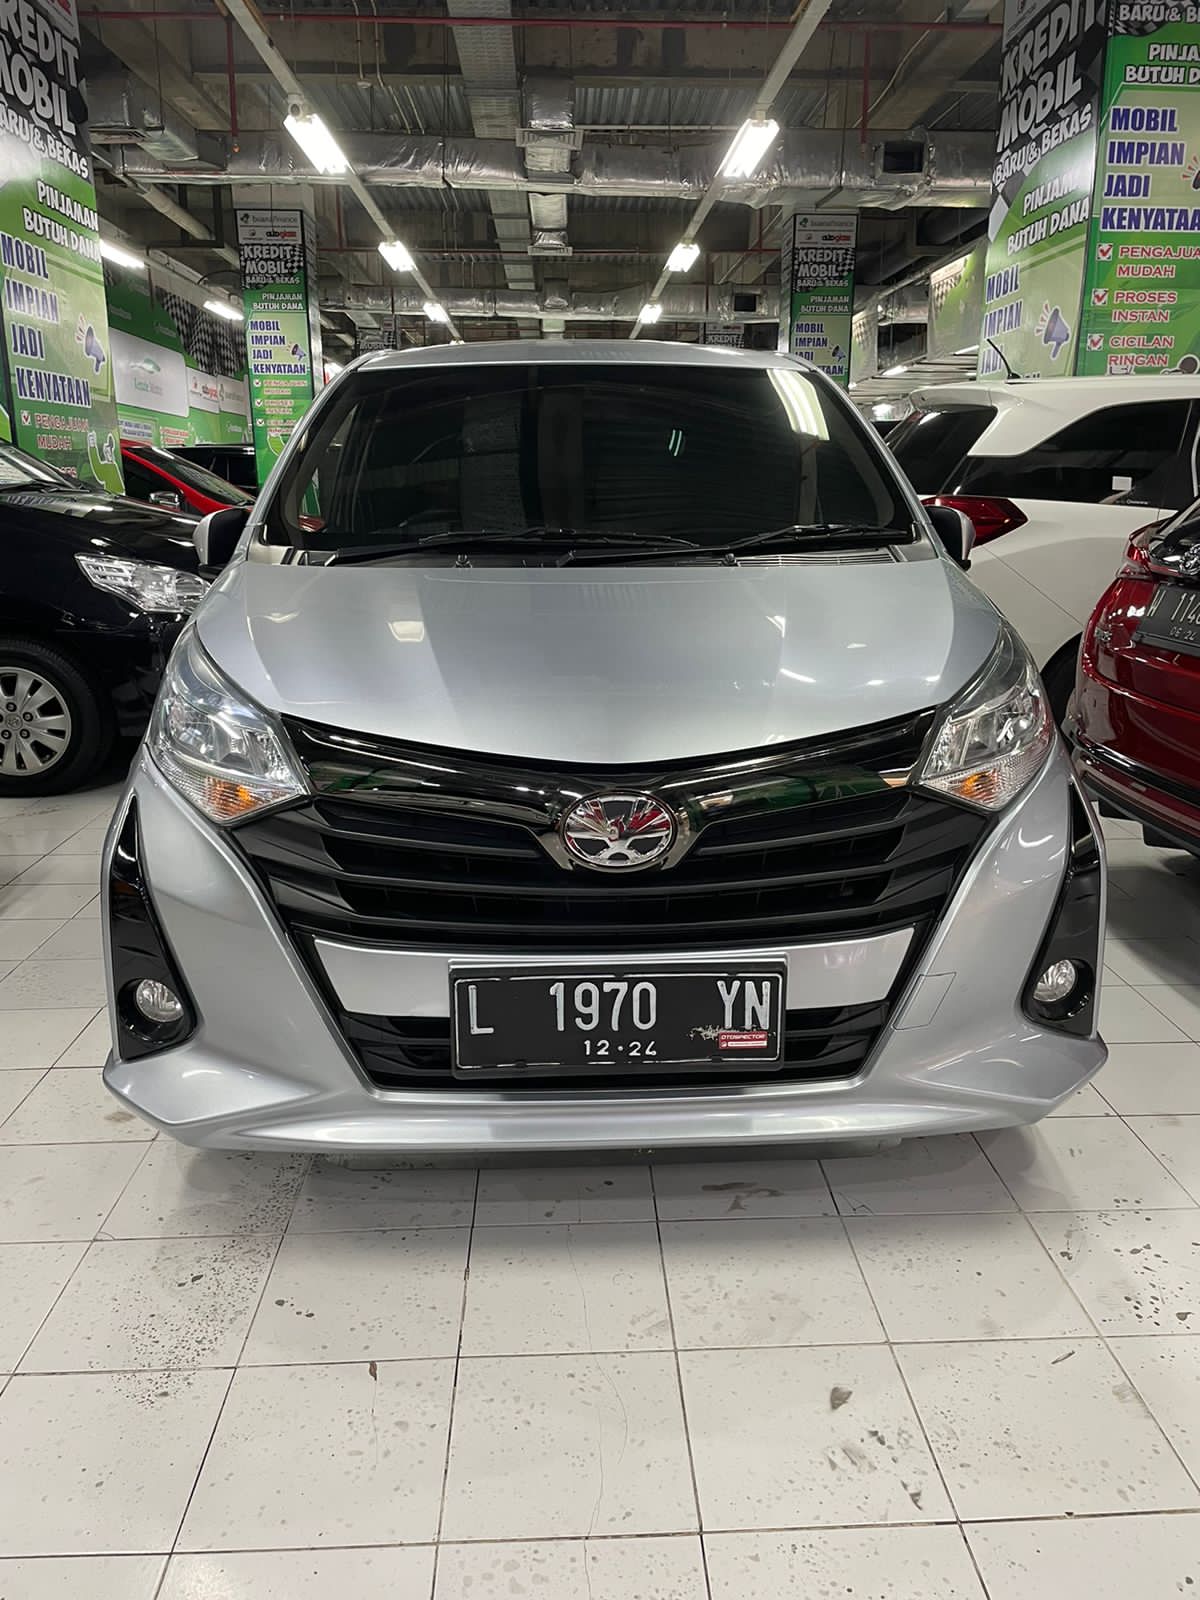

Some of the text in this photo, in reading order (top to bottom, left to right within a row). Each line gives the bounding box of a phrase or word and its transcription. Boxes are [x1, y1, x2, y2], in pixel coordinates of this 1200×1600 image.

[1119, 4, 1166, 22] BARU
[1168, 7, 1182, 22] &
[1125, 65, 1185, 83] BUTUH
[997, 51, 1082, 153] MOBIL
[1110, 107, 1178, 132] MOBIL
[993, 103, 1092, 187] BARU & BEKAS
[33, 128, 45, 151] &
[47, 134, 89, 179] BEKAS
[1107, 141, 1185, 165] IMPIAN
[1103, 174, 1150, 198] JADI
[37, 180, 99, 232] PINJAMAN
[23, 208, 69, 247] BUTUH
[1007, 197, 1090, 256] BUTUH DANA
[1, 232, 49, 279] MOBIL
[243, 245, 293, 259] KREDIT
[799, 249, 846, 262] KREDIT
[245, 260, 289, 274] MOBIL
[797, 264, 839, 277] MOBIL
[1117, 265, 1176, 277] MUDAH
[986, 263, 1020, 304] MOBIL
[6, 279, 59, 322] IMPIAN
[261, 292, 303, 301] PINJAMAN
[810, 295, 850, 303] PINJAMAN
[1114, 291, 1178, 303] PROSES
[252, 302, 304, 311] BUTUH DANA
[828, 304, 849, 312] DANA
[983, 301, 1023, 339] IMPIAN
[1112, 310, 1169, 322] INSTAN
[249, 320, 281, 331] MOBIL
[795, 323, 825, 334] MOBIL
[11, 323, 44, 359] JADI
[251, 335, 286, 346] IMPIAN
[795, 337, 828, 348] IMPIAN
[1110, 335, 1175, 348] CICILAN
[252, 349, 273, 360] JADI
[1108, 354, 1169, 366] RINGAN
[252, 363, 306, 374] KENYATAAN
[16, 367, 91, 406] KENYATAAN
[468, 979, 771, 1035] L 1970 YN
